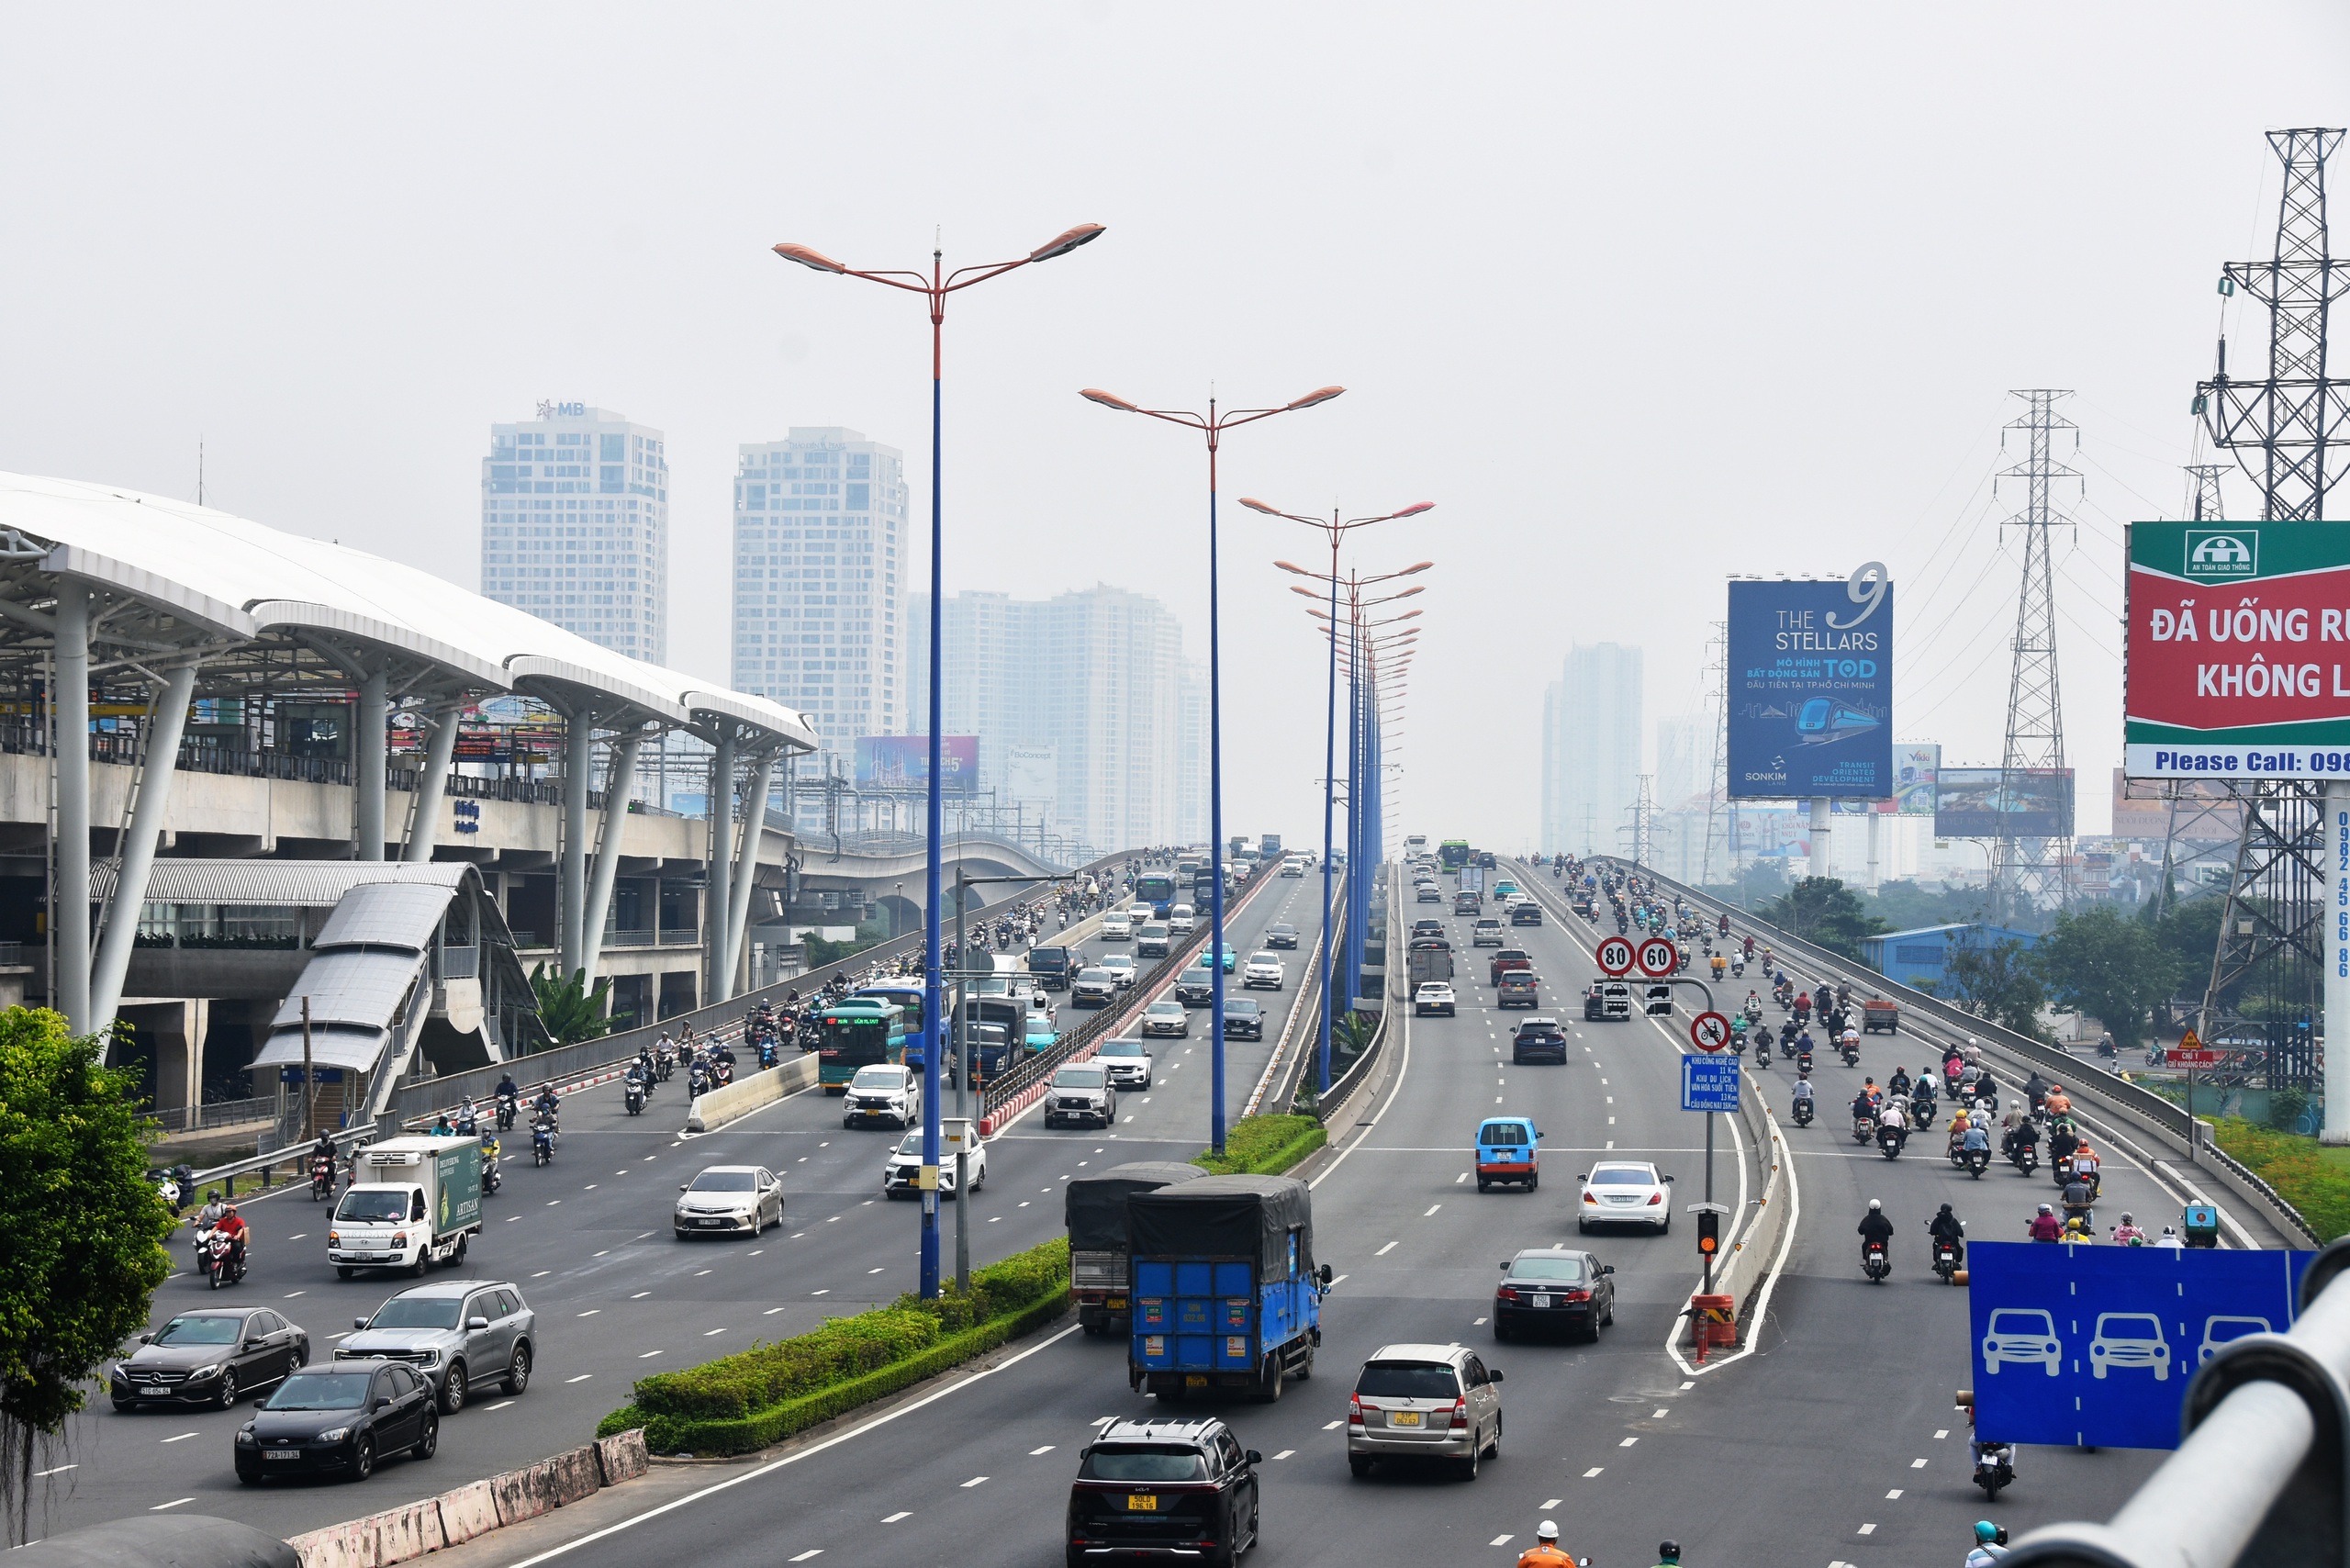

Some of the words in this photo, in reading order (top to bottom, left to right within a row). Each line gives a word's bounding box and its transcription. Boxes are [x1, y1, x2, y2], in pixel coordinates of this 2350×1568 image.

[558, 402, 584, 416] MB
[2201, 563, 2216, 571] TOÀN
[2232, 563, 2251, 571] THÔNG
[1775, 610, 1814, 629] THE
[1825, 561, 1888, 630] 9
[2150, 599, 2199, 642] ĐÃ
[2209, 597, 2309, 643] UỐNG
[2321, 609, 2350, 642] R
[1775, 633, 1878, 651] STELLARS
[1776, 657, 1793, 667] MÔ
[1796, 657, 1820, 667] HÌNH
[1823, 659, 1877, 678] TOD
[1747, 667, 1765, 678] BẤT
[1768, 668, 1797, 679] ĐỘNG
[2198, 652, 2321, 698] KHÔNG
[1768, 680, 1788, 689] TIÊN
[1791, 681, 1804, 690] TẠI
[1834, 679, 1850, 689] CHÍ
[1014, 752, 1051, 761] BoConcept
[1908, 750, 1930, 762] Vikki
[2155, 751, 2238, 771] Please
[2247, 752, 2301, 772] Call:
[1745, 772, 1786, 780] SONKIM
[1606, 947, 1626, 966] 80
[1647, 947, 1667, 966] 60
[1691, 1057, 1702, 1065] KHU
[1728, 1058, 1738, 1066] CAO
[1695, 1074, 1707, 1082] KHU
[455, 1197, 478, 1216] ARTISAN
